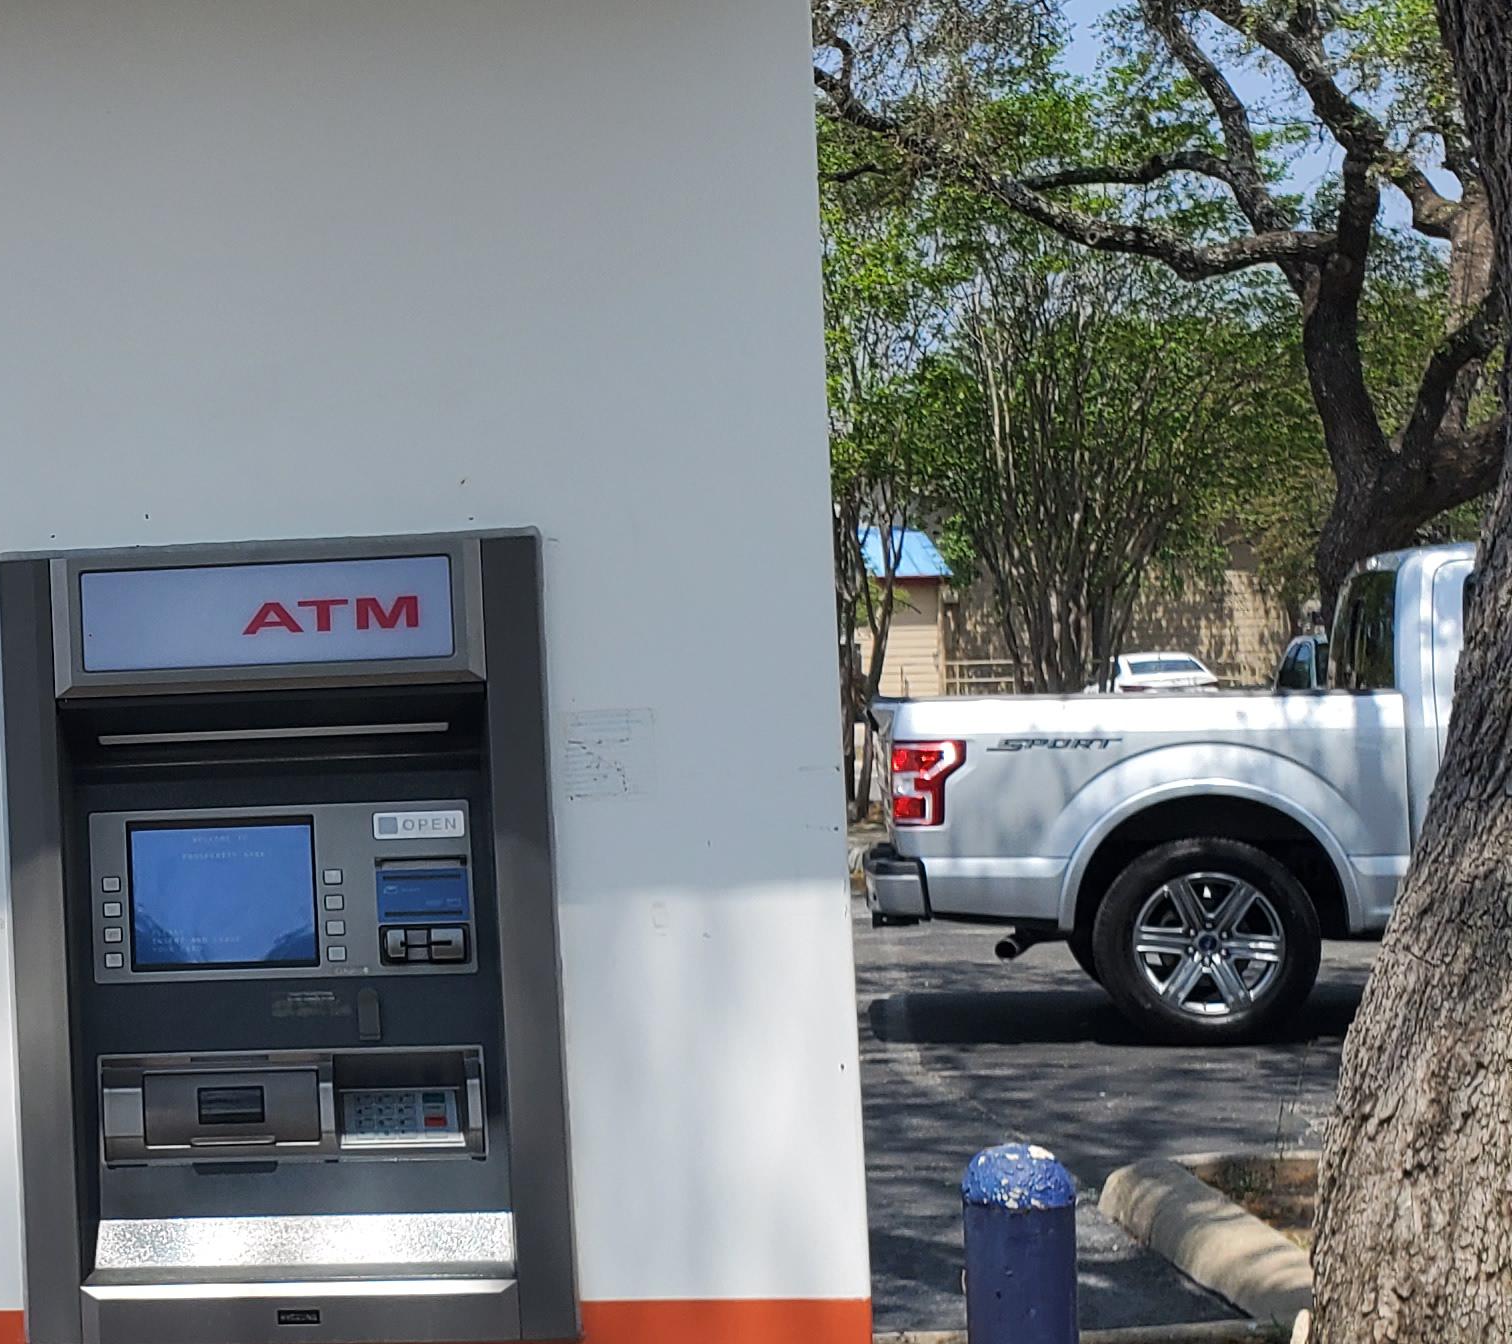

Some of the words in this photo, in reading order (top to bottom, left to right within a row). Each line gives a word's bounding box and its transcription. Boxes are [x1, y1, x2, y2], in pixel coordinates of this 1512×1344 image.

[241, 595, 420, 636] ATM
[986, 737, 1123, 752] SPORT
[402, 817, 457, 832] OPEN
